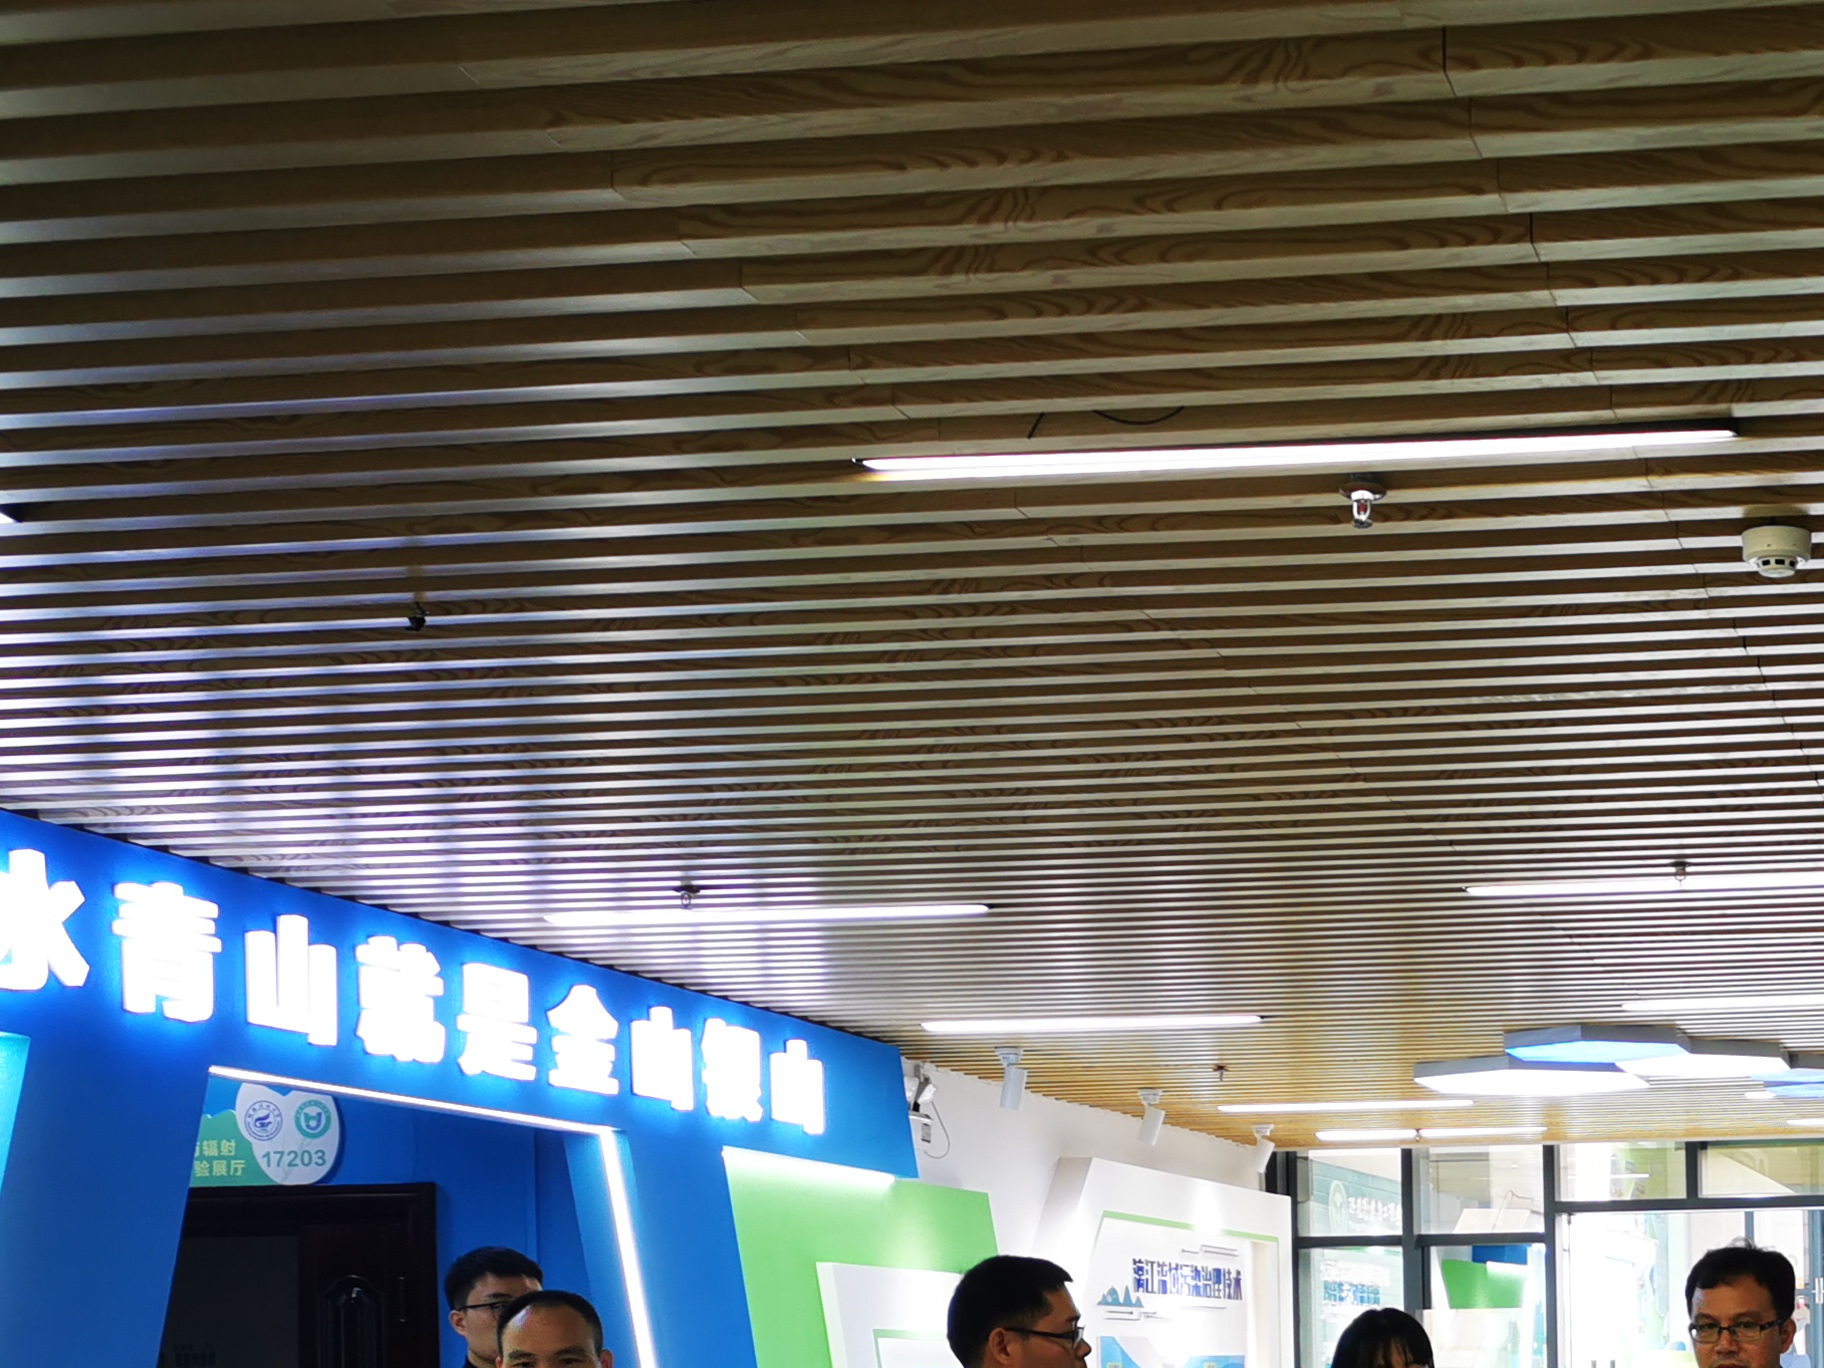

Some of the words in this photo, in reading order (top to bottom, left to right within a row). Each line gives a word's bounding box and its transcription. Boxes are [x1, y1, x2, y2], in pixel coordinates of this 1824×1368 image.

[0, 848, 825, 1135] 水青山就是金山银山
[262, 1150, 327, 1168] 17203
